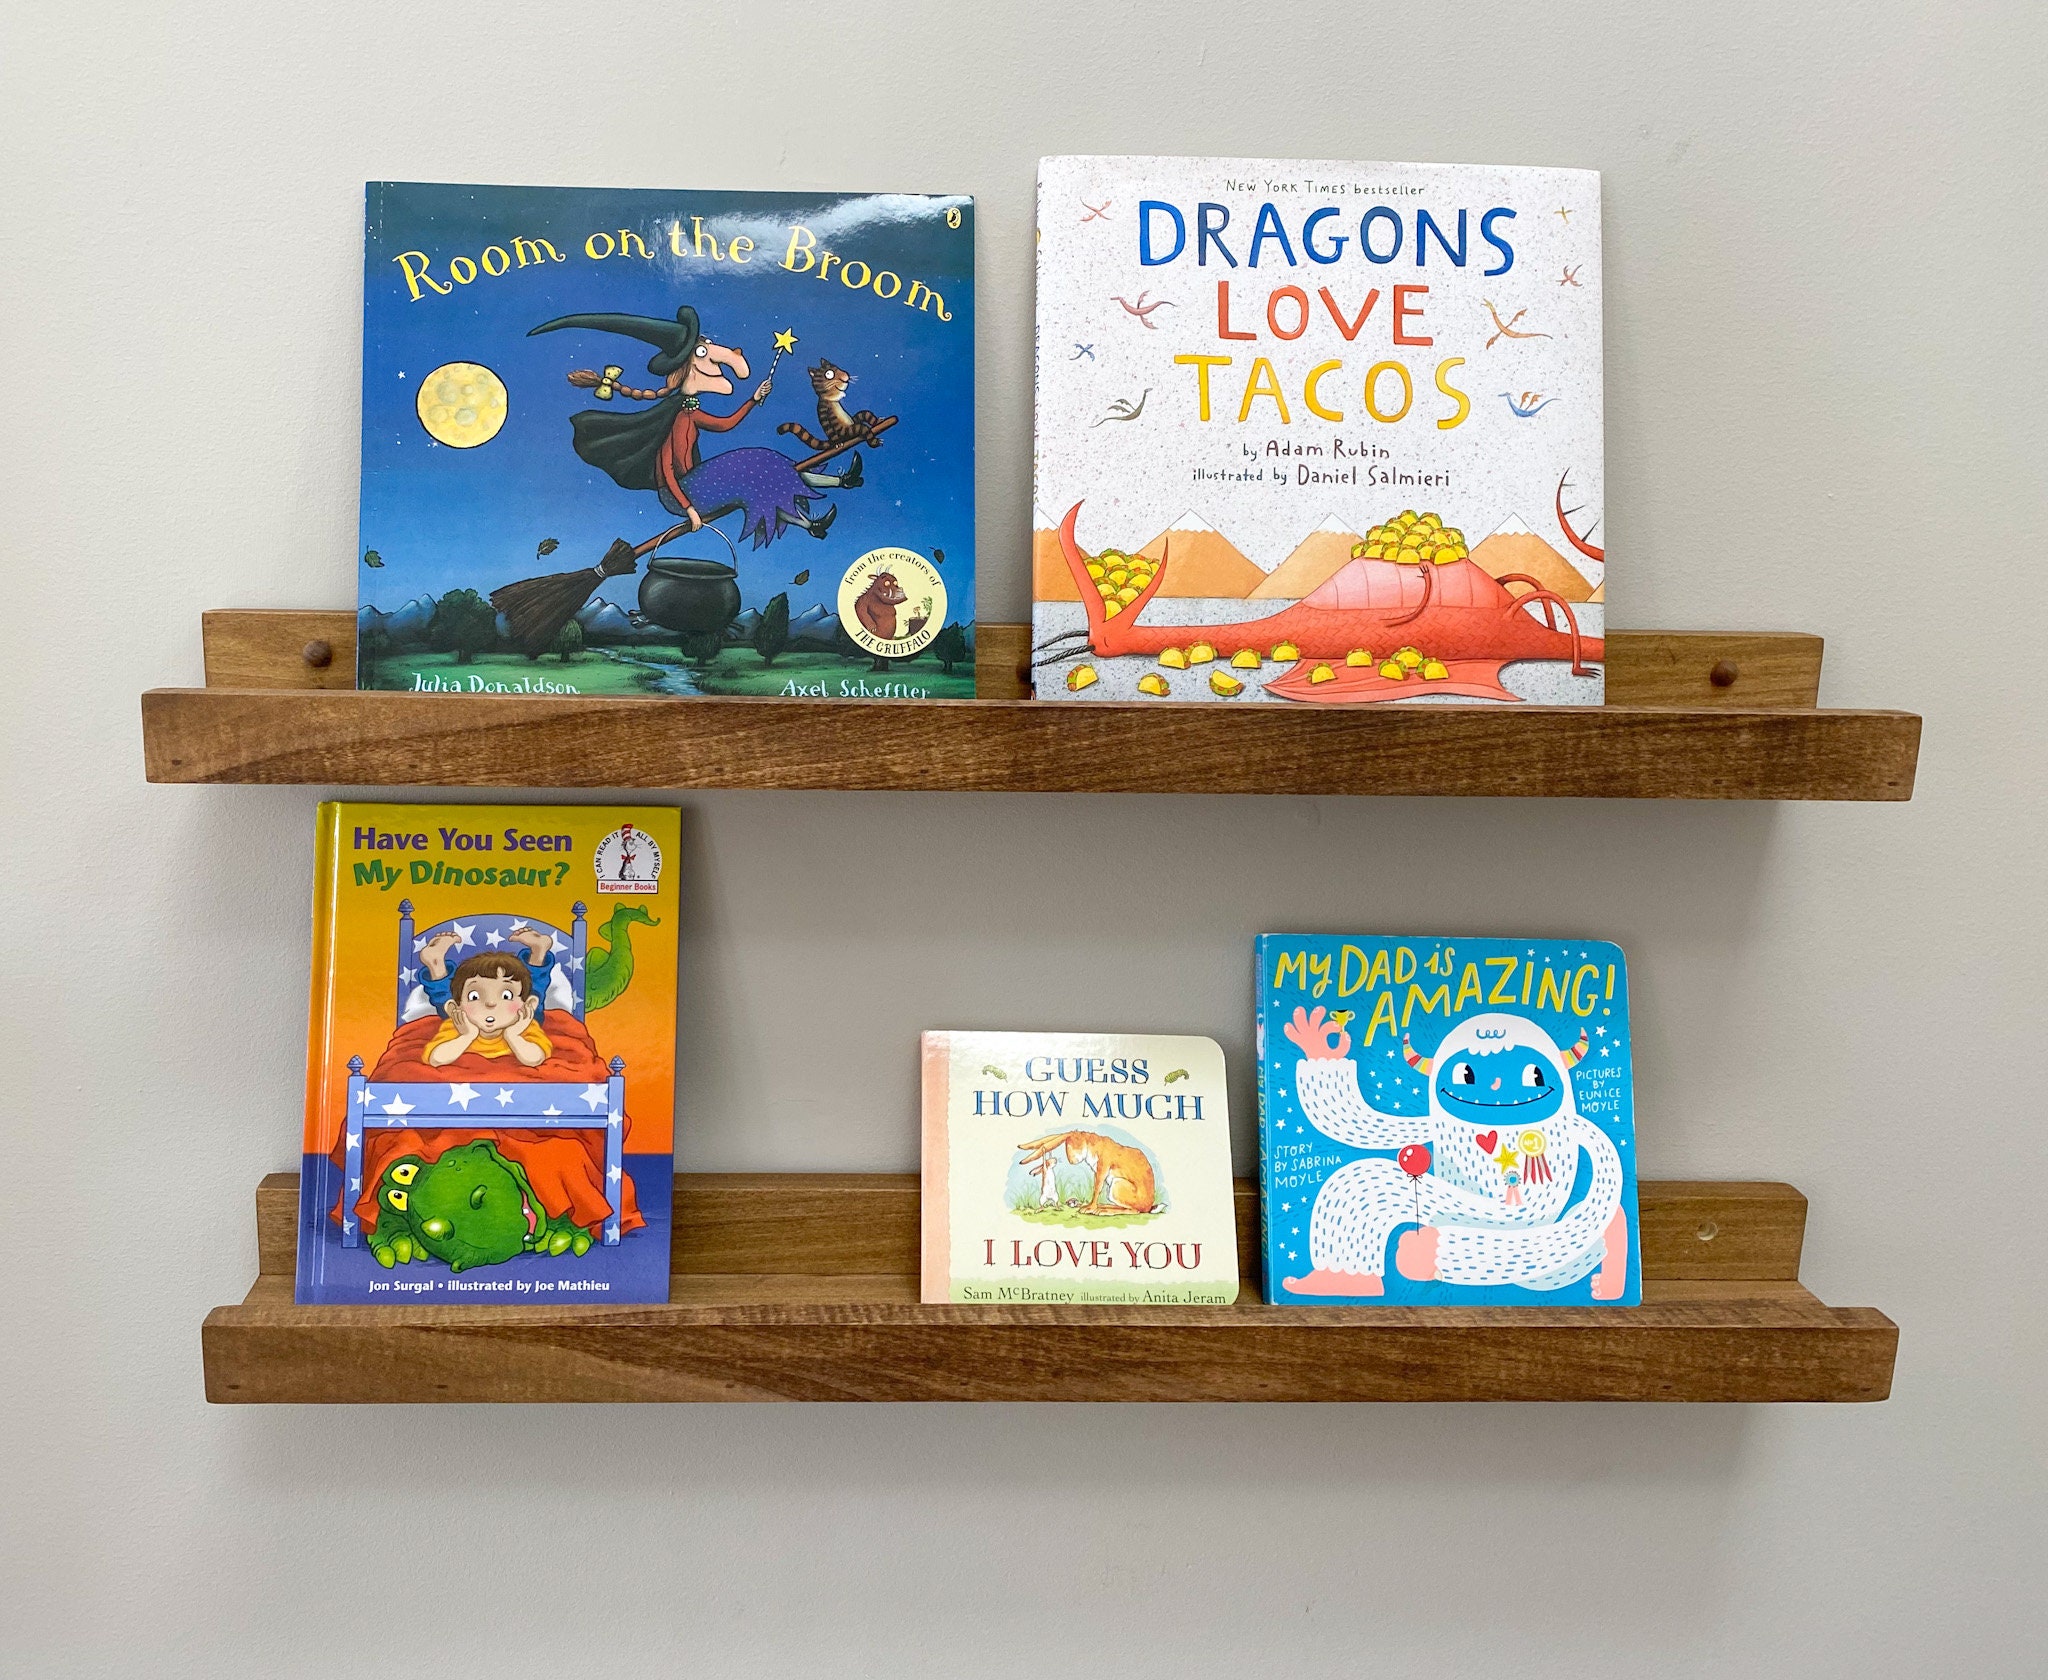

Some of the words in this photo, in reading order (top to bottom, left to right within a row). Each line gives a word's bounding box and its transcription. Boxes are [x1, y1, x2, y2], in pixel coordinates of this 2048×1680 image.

[1354, 183, 1425, 195] bestseller
[1138, 200, 1517, 277] DRAGONS
[392, 234, 566, 302] Room
[584, 228, 655, 260] on
[669, 216, 755, 264] the
[777, 225, 953, 321] Broom
[1217, 280, 1433, 346] LOVE
[1174, 354, 1471, 430] TACOS
[1243, 443, 1257, 461] by
[1266, 440, 1323, 457] Adam
[1334, 438, 1390, 459] Rubin
[1193, 468, 1263, 481] illustrated
[1273, 468, 1287, 485] by
[1298, 464, 1356, 486] Daniel
[1368, 464, 1450, 486] Salmieri
[844, 561, 867, 585] from
[868, 553, 885, 564] the
[889, 552, 930, 575] creators
[929, 575, 942, 586] of
[855, 628, 876, 649] THE
[876, 629, 931, 655] GRUFFALO
[409, 672, 461, 693] Julia
[467, 674, 580, 695] Donaldson
[779, 679, 829, 698] Axel
[839, 679, 931, 699] Scheffler
[353, 827, 429, 850] Have
[438, 828, 493, 851] You
[503, 828, 572, 852] Seen
[611, 831, 619, 839] IT
[636, 832, 648, 842] ALL
[647, 840, 658, 850] BY
[597, 837, 612, 856] READ
[352, 859, 403, 891] My
[409, 860, 570, 887] Dinosaur?
[595, 857, 603, 874] CAN
[651, 851, 661, 879] MYSELF
[600, 883, 632, 891] Beginner
[634, 882, 656, 891] Books
[1338, 944, 1417, 998] DAD
[1425, 943, 1456, 977] is
[1363, 956, 1616, 1047] AMAZING!
[1025, 1056, 1150, 1085] GUESS
[1576, 1066, 1622, 1081] PICTURES
[1579, 1087, 1621, 1100] EUNICE
[1592, 1079, 1605, 1089] BY
[972, 1090, 1069, 1117] HOW
[1082, 1092, 1205, 1121] MUCH
[1582, 1100, 1619, 1113] MOYLE
[1274, 1142, 1313, 1159] STORY
[1274, 1161, 1287, 1173] BY
[1291, 1155, 1342, 1172] SABRINA
[1275, 1170, 1323, 1189] MOYLE
[983, 1239, 996, 1266] I
[1010, 1239, 1113, 1269] LOVE
[1120, 1241, 1203, 1270] YOU
[368, 1280, 390, 1294] Jon
[393, 1280, 434, 1294] Surgal
[447, 1279, 513, 1292] illustrated
[516, 1279, 532, 1294] by
[534, 1280, 554, 1294] Joe
[558, 1279, 610, 1292] Mathieu
[963, 1286, 992, 1300] Sam
[998, 1287, 1075, 1305] McBratney
[1080, 1291, 1126, 1302] illustrated
[1128, 1292, 1140, 1305] by
[1142, 1289, 1178, 1304] Anita
[1183, 1290, 1226, 1305] Jeram
